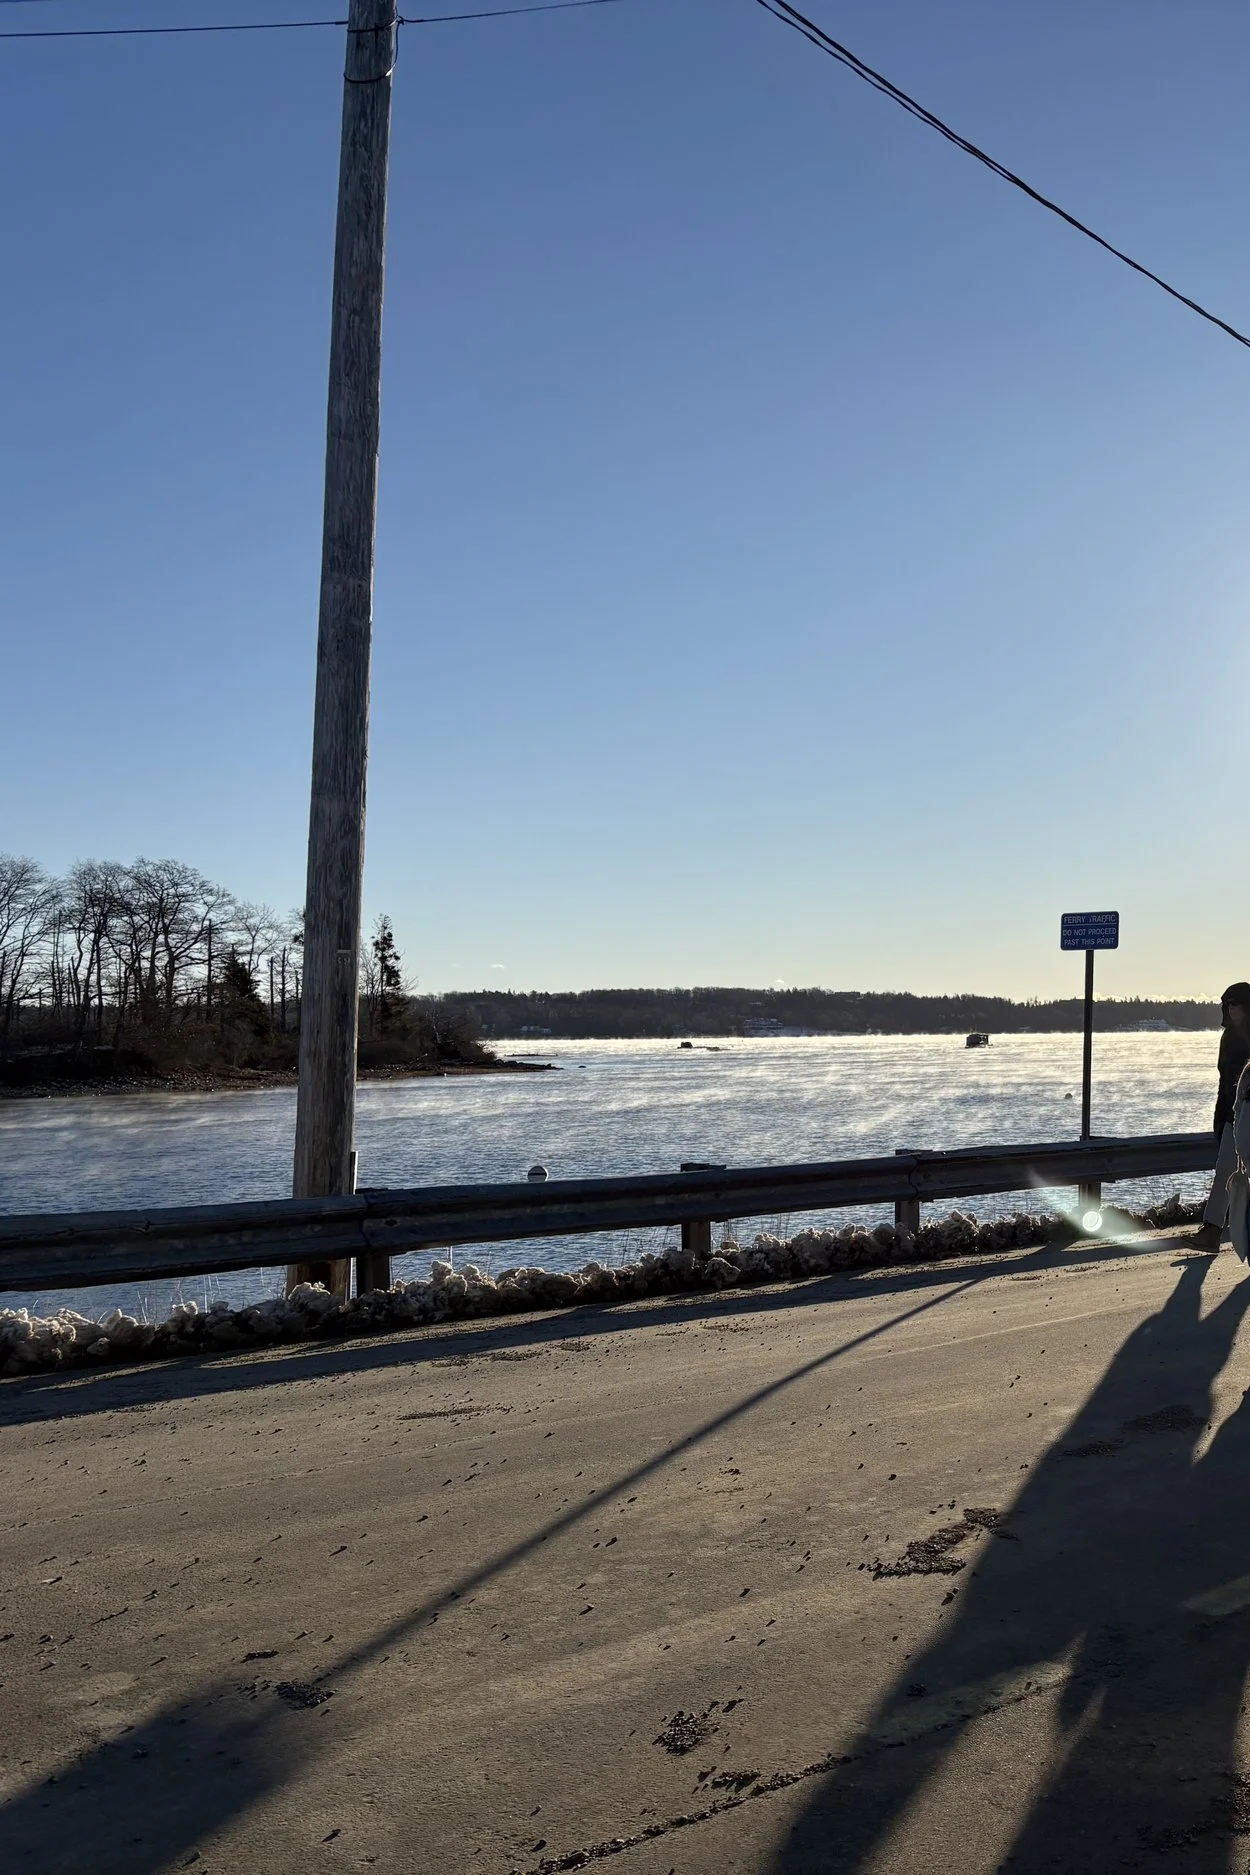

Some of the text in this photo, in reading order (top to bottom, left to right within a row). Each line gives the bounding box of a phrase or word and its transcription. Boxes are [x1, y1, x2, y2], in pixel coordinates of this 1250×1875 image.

[1063, 914, 1116, 924] FERRY TRAFFIC
[1088, 927, 1117, 935] PROCEED
[1096, 937, 1115, 945] POINT
